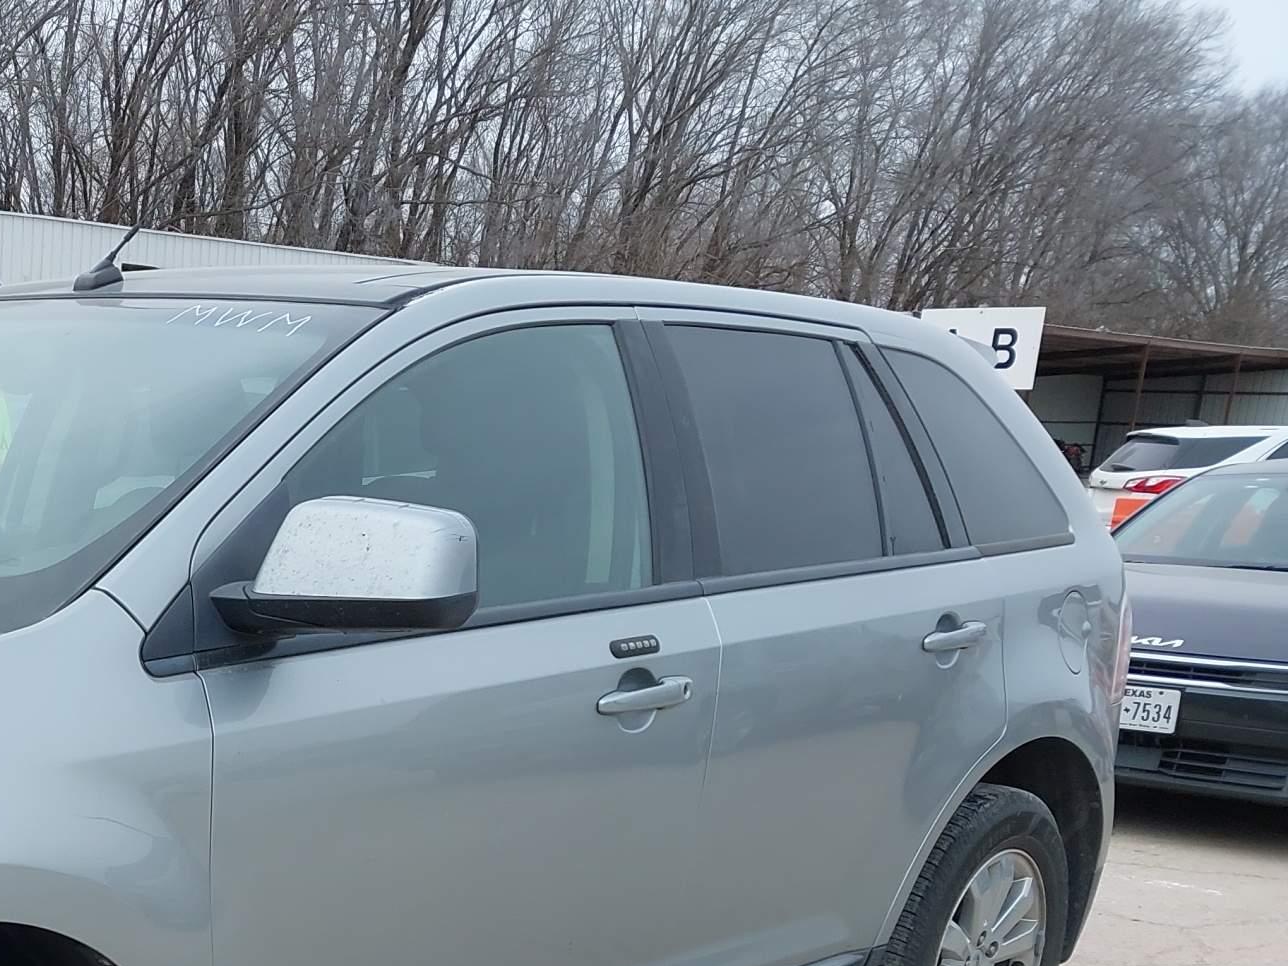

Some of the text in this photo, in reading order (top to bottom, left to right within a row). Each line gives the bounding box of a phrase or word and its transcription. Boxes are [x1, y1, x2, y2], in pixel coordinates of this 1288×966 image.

[166, 304, 312, 337] MWM
[992, 327, 1018, 370] B
[1124, 688, 1152, 699] EXAS
